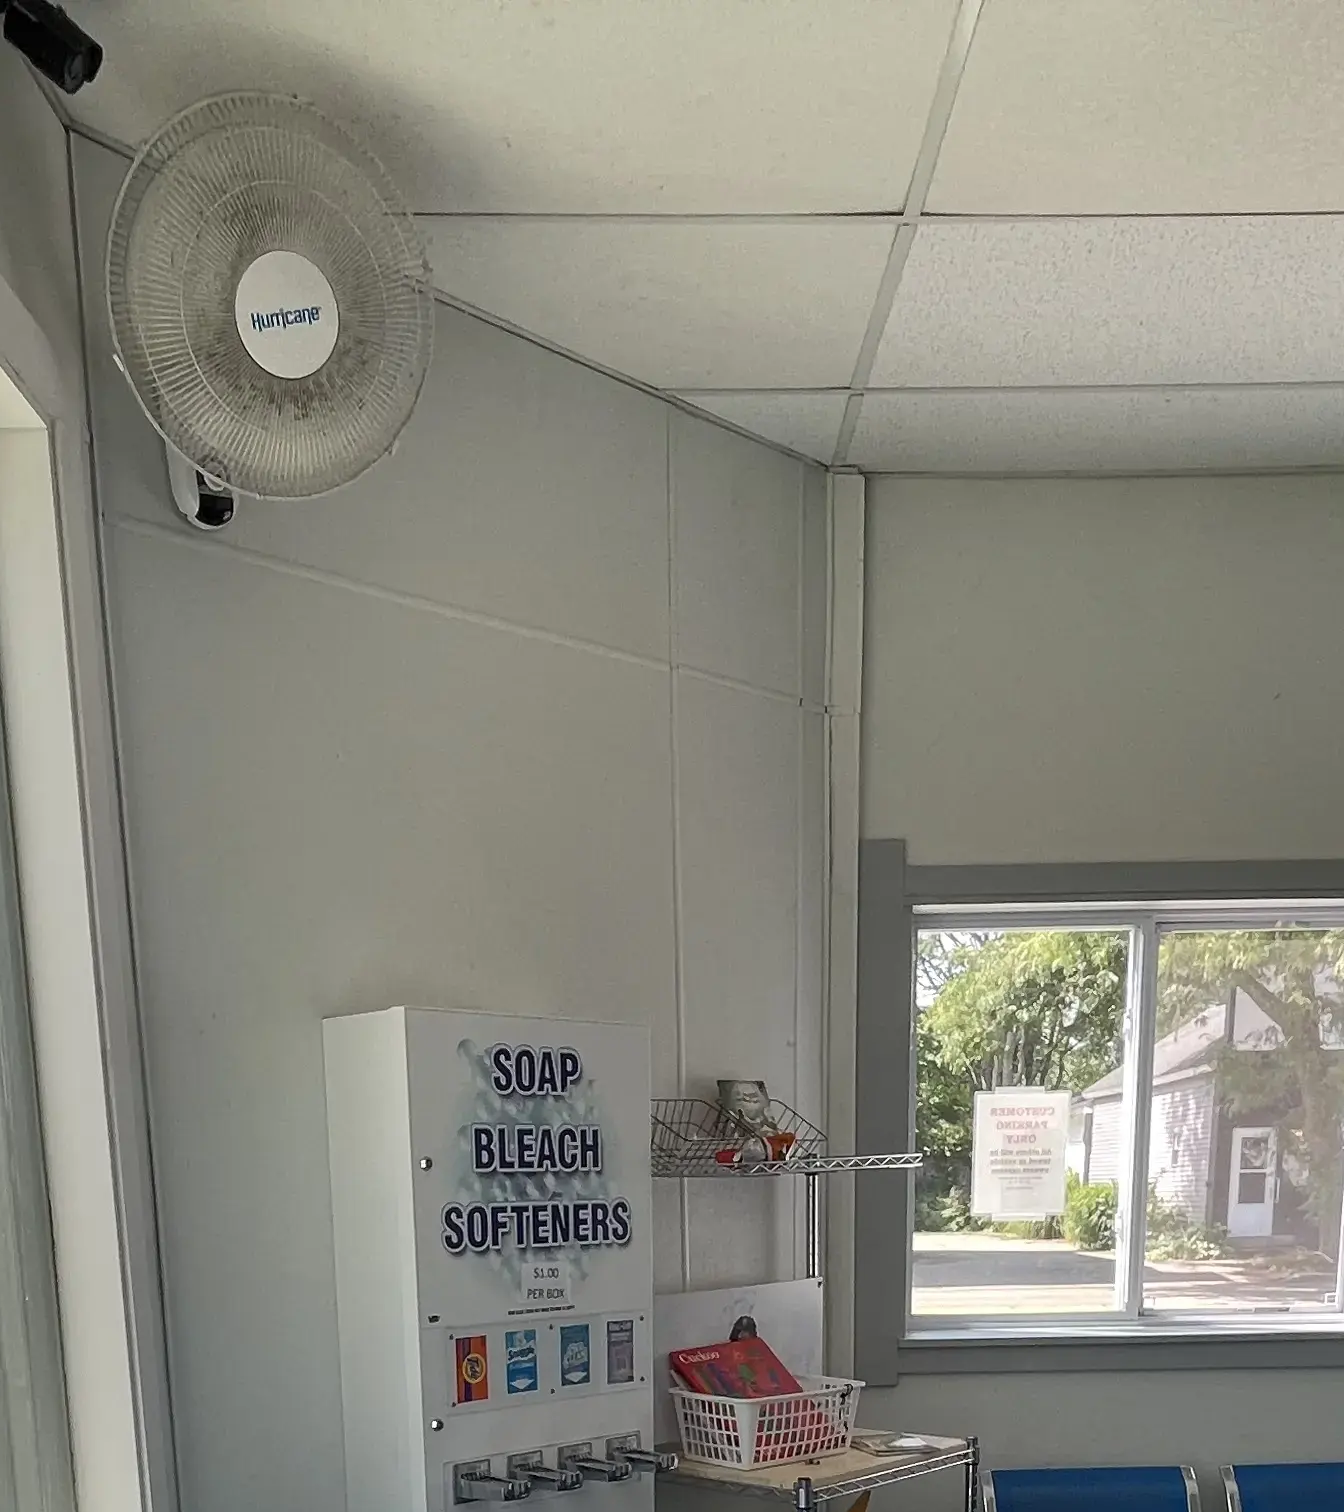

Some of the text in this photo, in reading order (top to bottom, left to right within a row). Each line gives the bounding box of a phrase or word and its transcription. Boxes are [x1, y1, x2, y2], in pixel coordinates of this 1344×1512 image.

[250, 306, 321, 332] Hurricane
[491, 1045, 581, 1095] SOAP
[471, 1125, 602, 1171] BLEACH
[442, 1198, 631, 1251] SOFTENERS
[533, 1267, 559, 1279] $1.00
[526, 1288, 565, 1299] PER BOX
